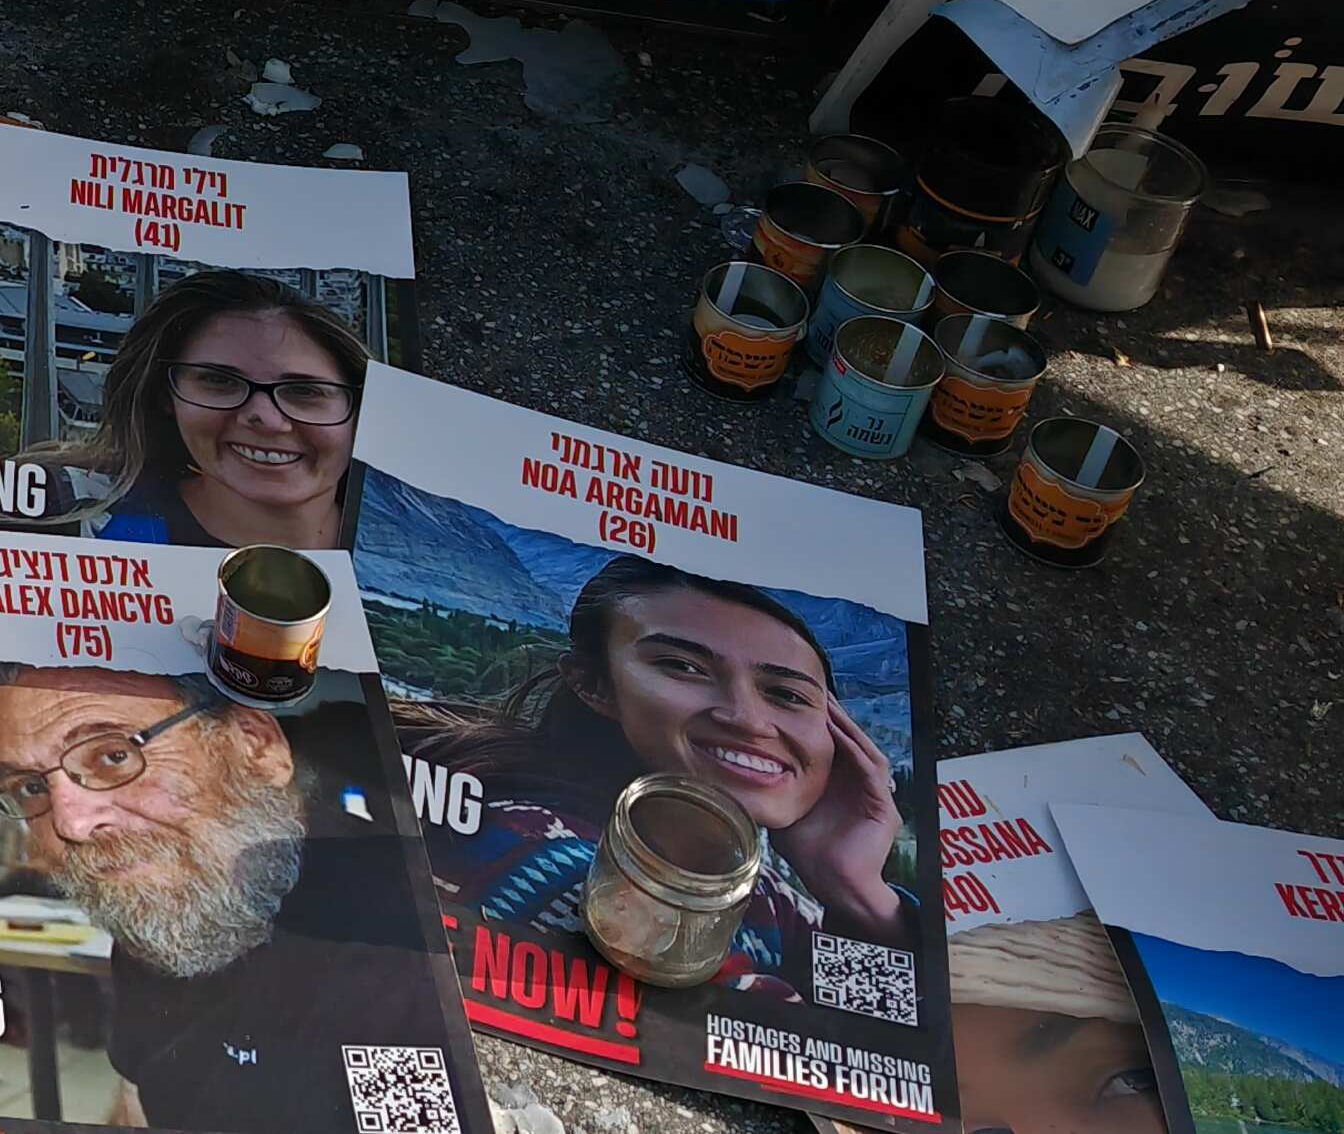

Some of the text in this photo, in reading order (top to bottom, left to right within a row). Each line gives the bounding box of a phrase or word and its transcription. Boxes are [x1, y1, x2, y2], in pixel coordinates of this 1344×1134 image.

[88, 153, 228, 199] נילי מרגלית
[69, 178, 248, 231] NILI MARGALIT
[133, 221, 181, 253] (41)
[845, 422, 893, 447] נשמה
[868, 415, 883, 434] נר
[550, 431, 714, 504] נועה ארגמני
[520, 456, 739, 544] NOA ARGAMANI
[598, 512, 657, 555] (26)
[75, 554, 155, 588] אלכס
[60, 586, 174, 626] DANCYG
[56, 620, 114, 661] (75)
[472, 926, 643, 1040] NOW!
[707, 1013, 932, 1085] HOSTAGES AND MISSING
[706, 1035, 931, 1116] FAMILIES FORUM
